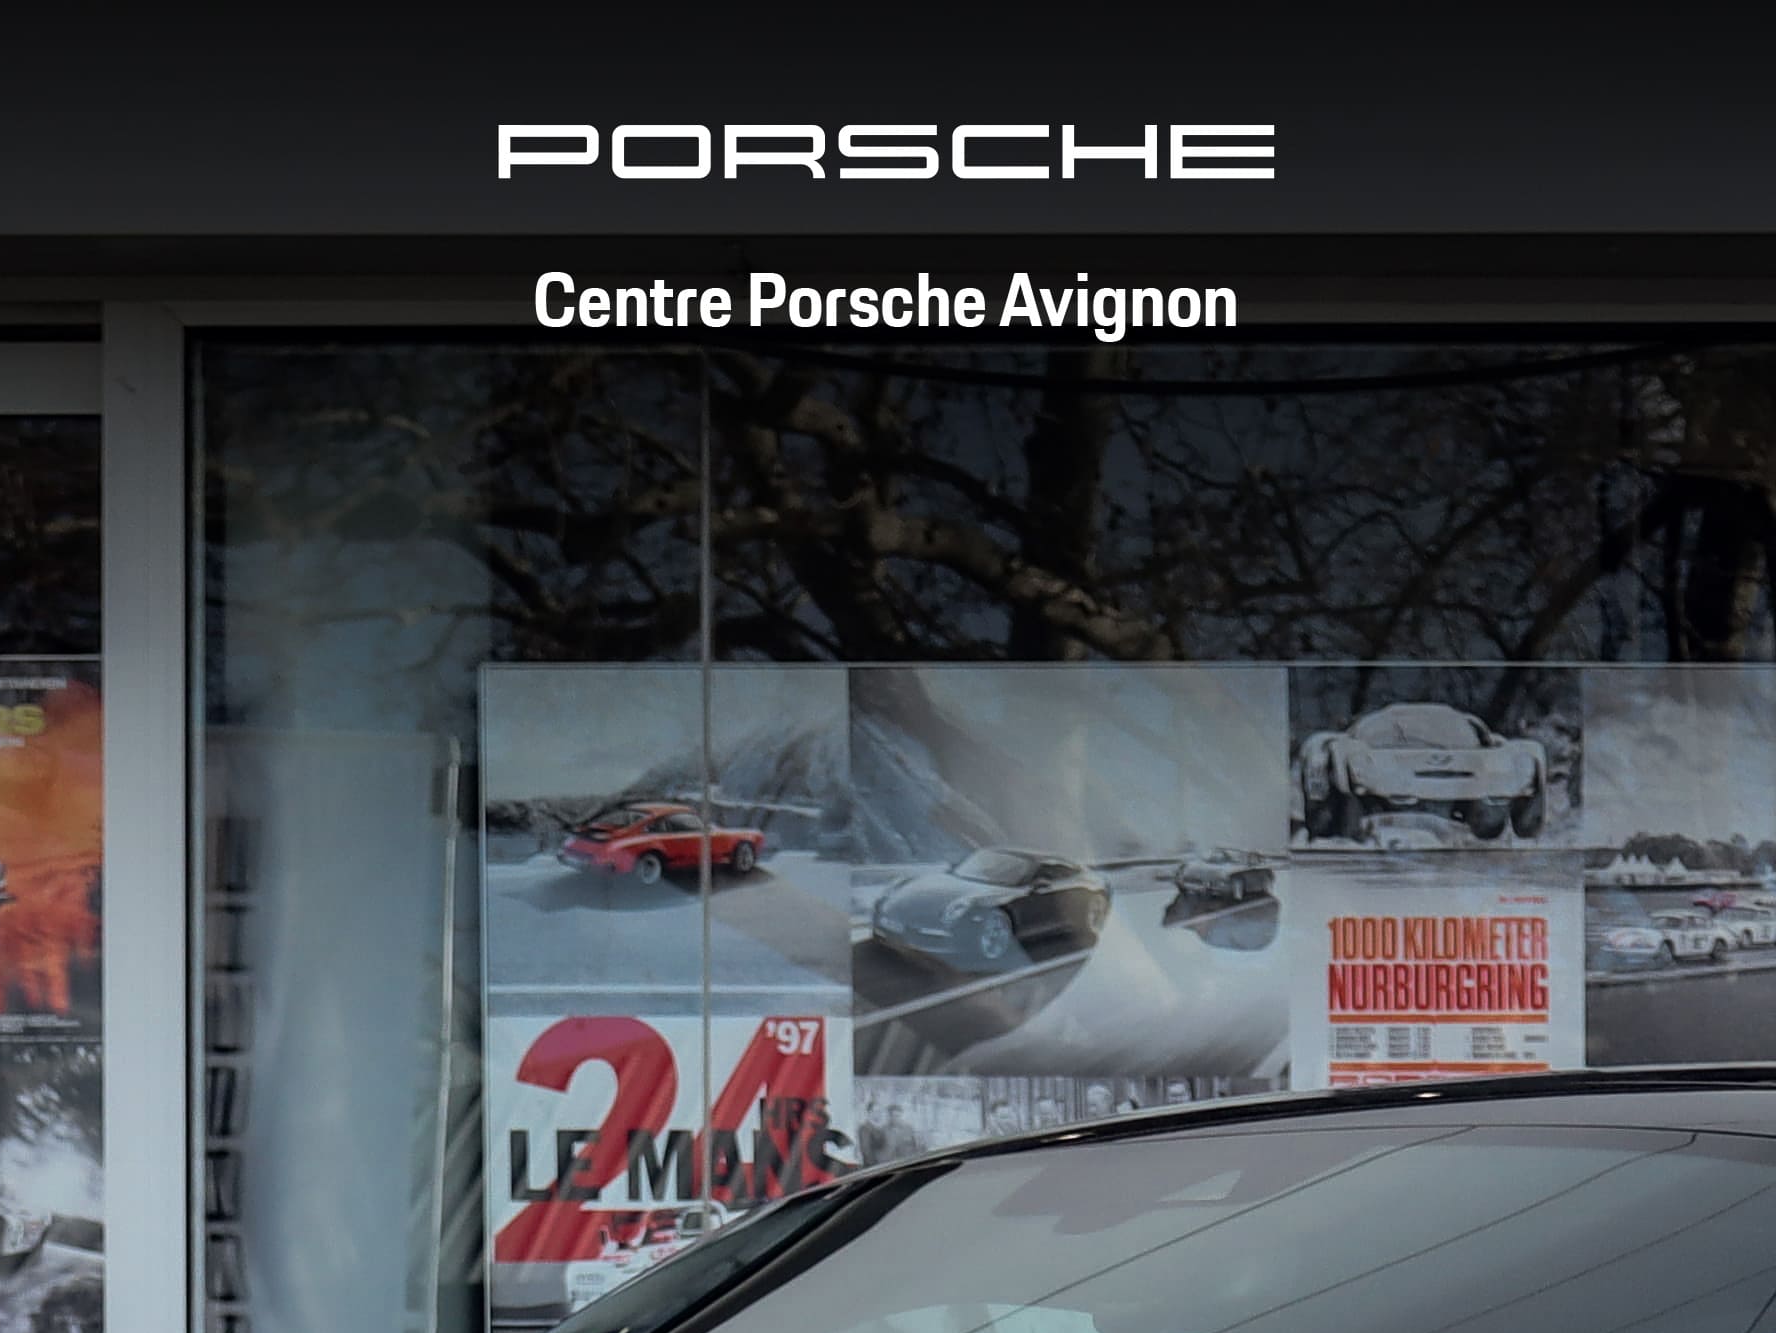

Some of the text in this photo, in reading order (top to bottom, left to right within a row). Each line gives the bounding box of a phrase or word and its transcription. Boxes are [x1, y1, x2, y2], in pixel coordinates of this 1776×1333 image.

[1329, 917, 1548, 961] 1000 KILOMETER
[766, 1021, 820, 1055] '97
[511, 1129, 864, 1208] LE MANS
